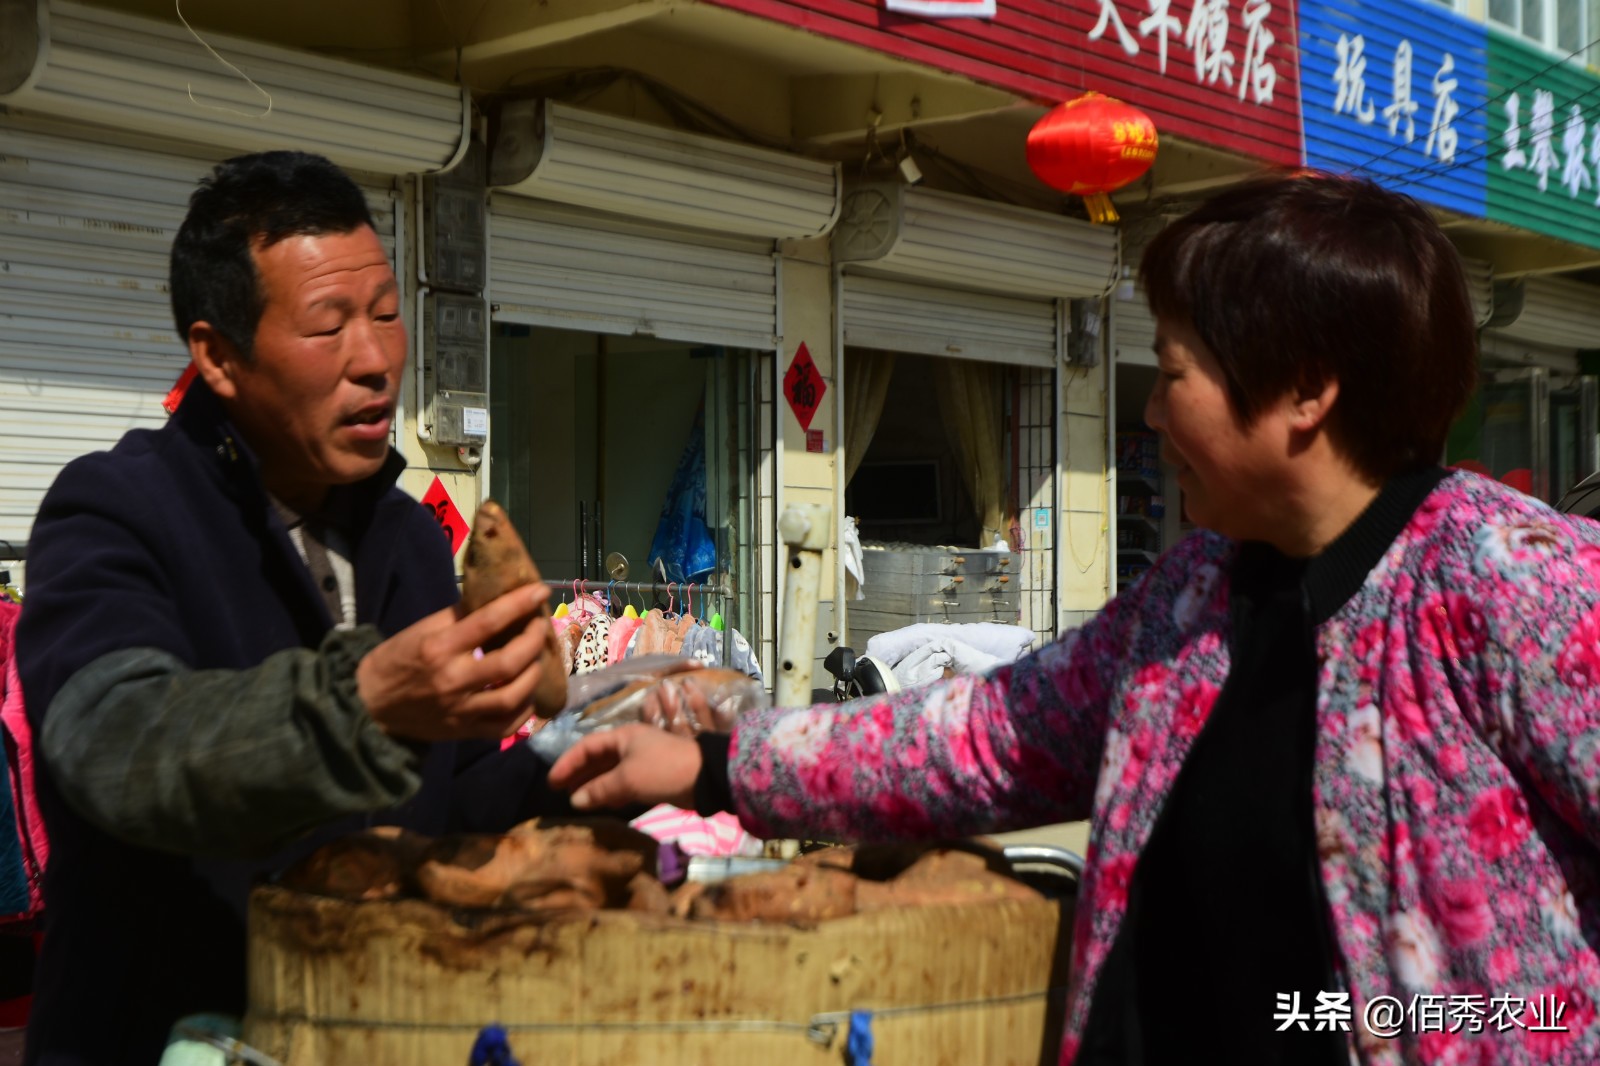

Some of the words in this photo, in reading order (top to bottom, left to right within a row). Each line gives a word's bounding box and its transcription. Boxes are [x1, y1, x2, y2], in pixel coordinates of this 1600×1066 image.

[1333, 32, 1459, 165] 玩具店
[792, 361, 816, 409] 福
